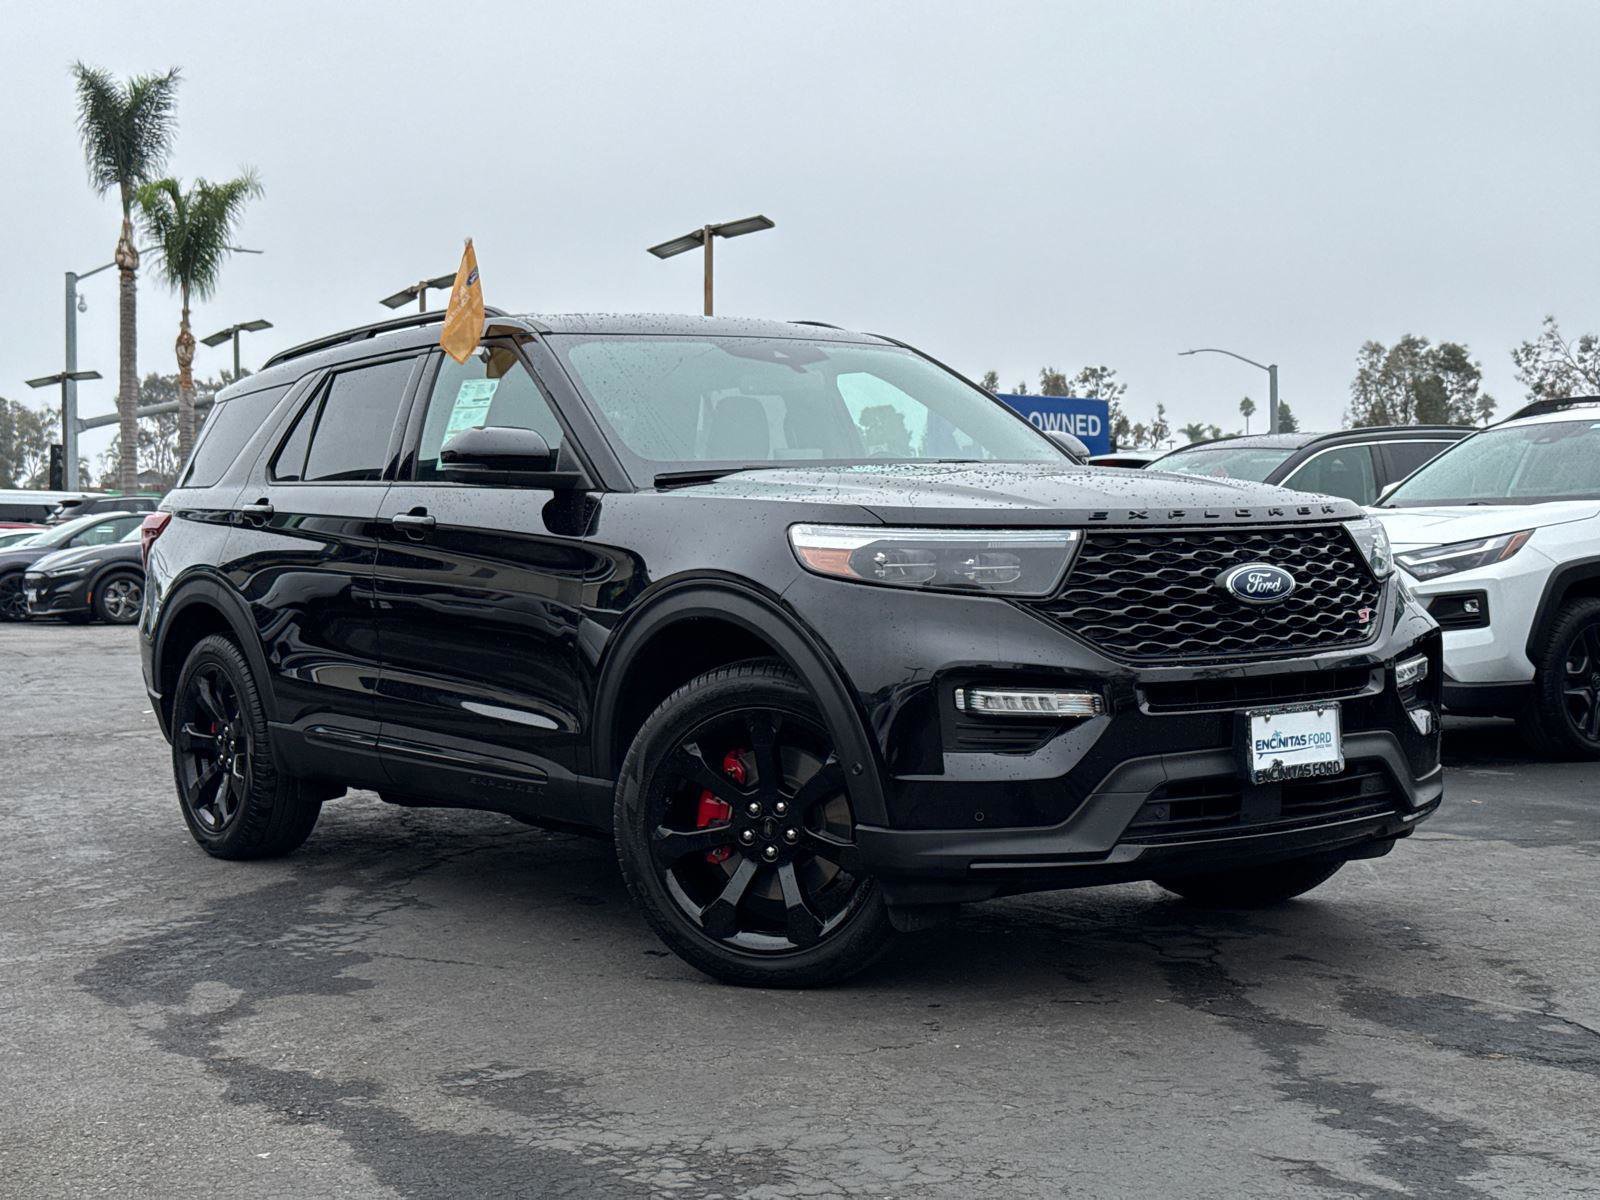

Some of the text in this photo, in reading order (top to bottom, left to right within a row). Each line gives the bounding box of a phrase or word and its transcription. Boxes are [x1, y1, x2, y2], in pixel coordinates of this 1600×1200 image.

[1028, 411, 1101, 436] OWNED
[1088, 505, 1336, 521] EXPLORER
[1246, 572, 1282, 593] Ford
[1255, 731, 1332, 751] ENCINITAS FORD
[1313, 761, 1341, 776] FORD
